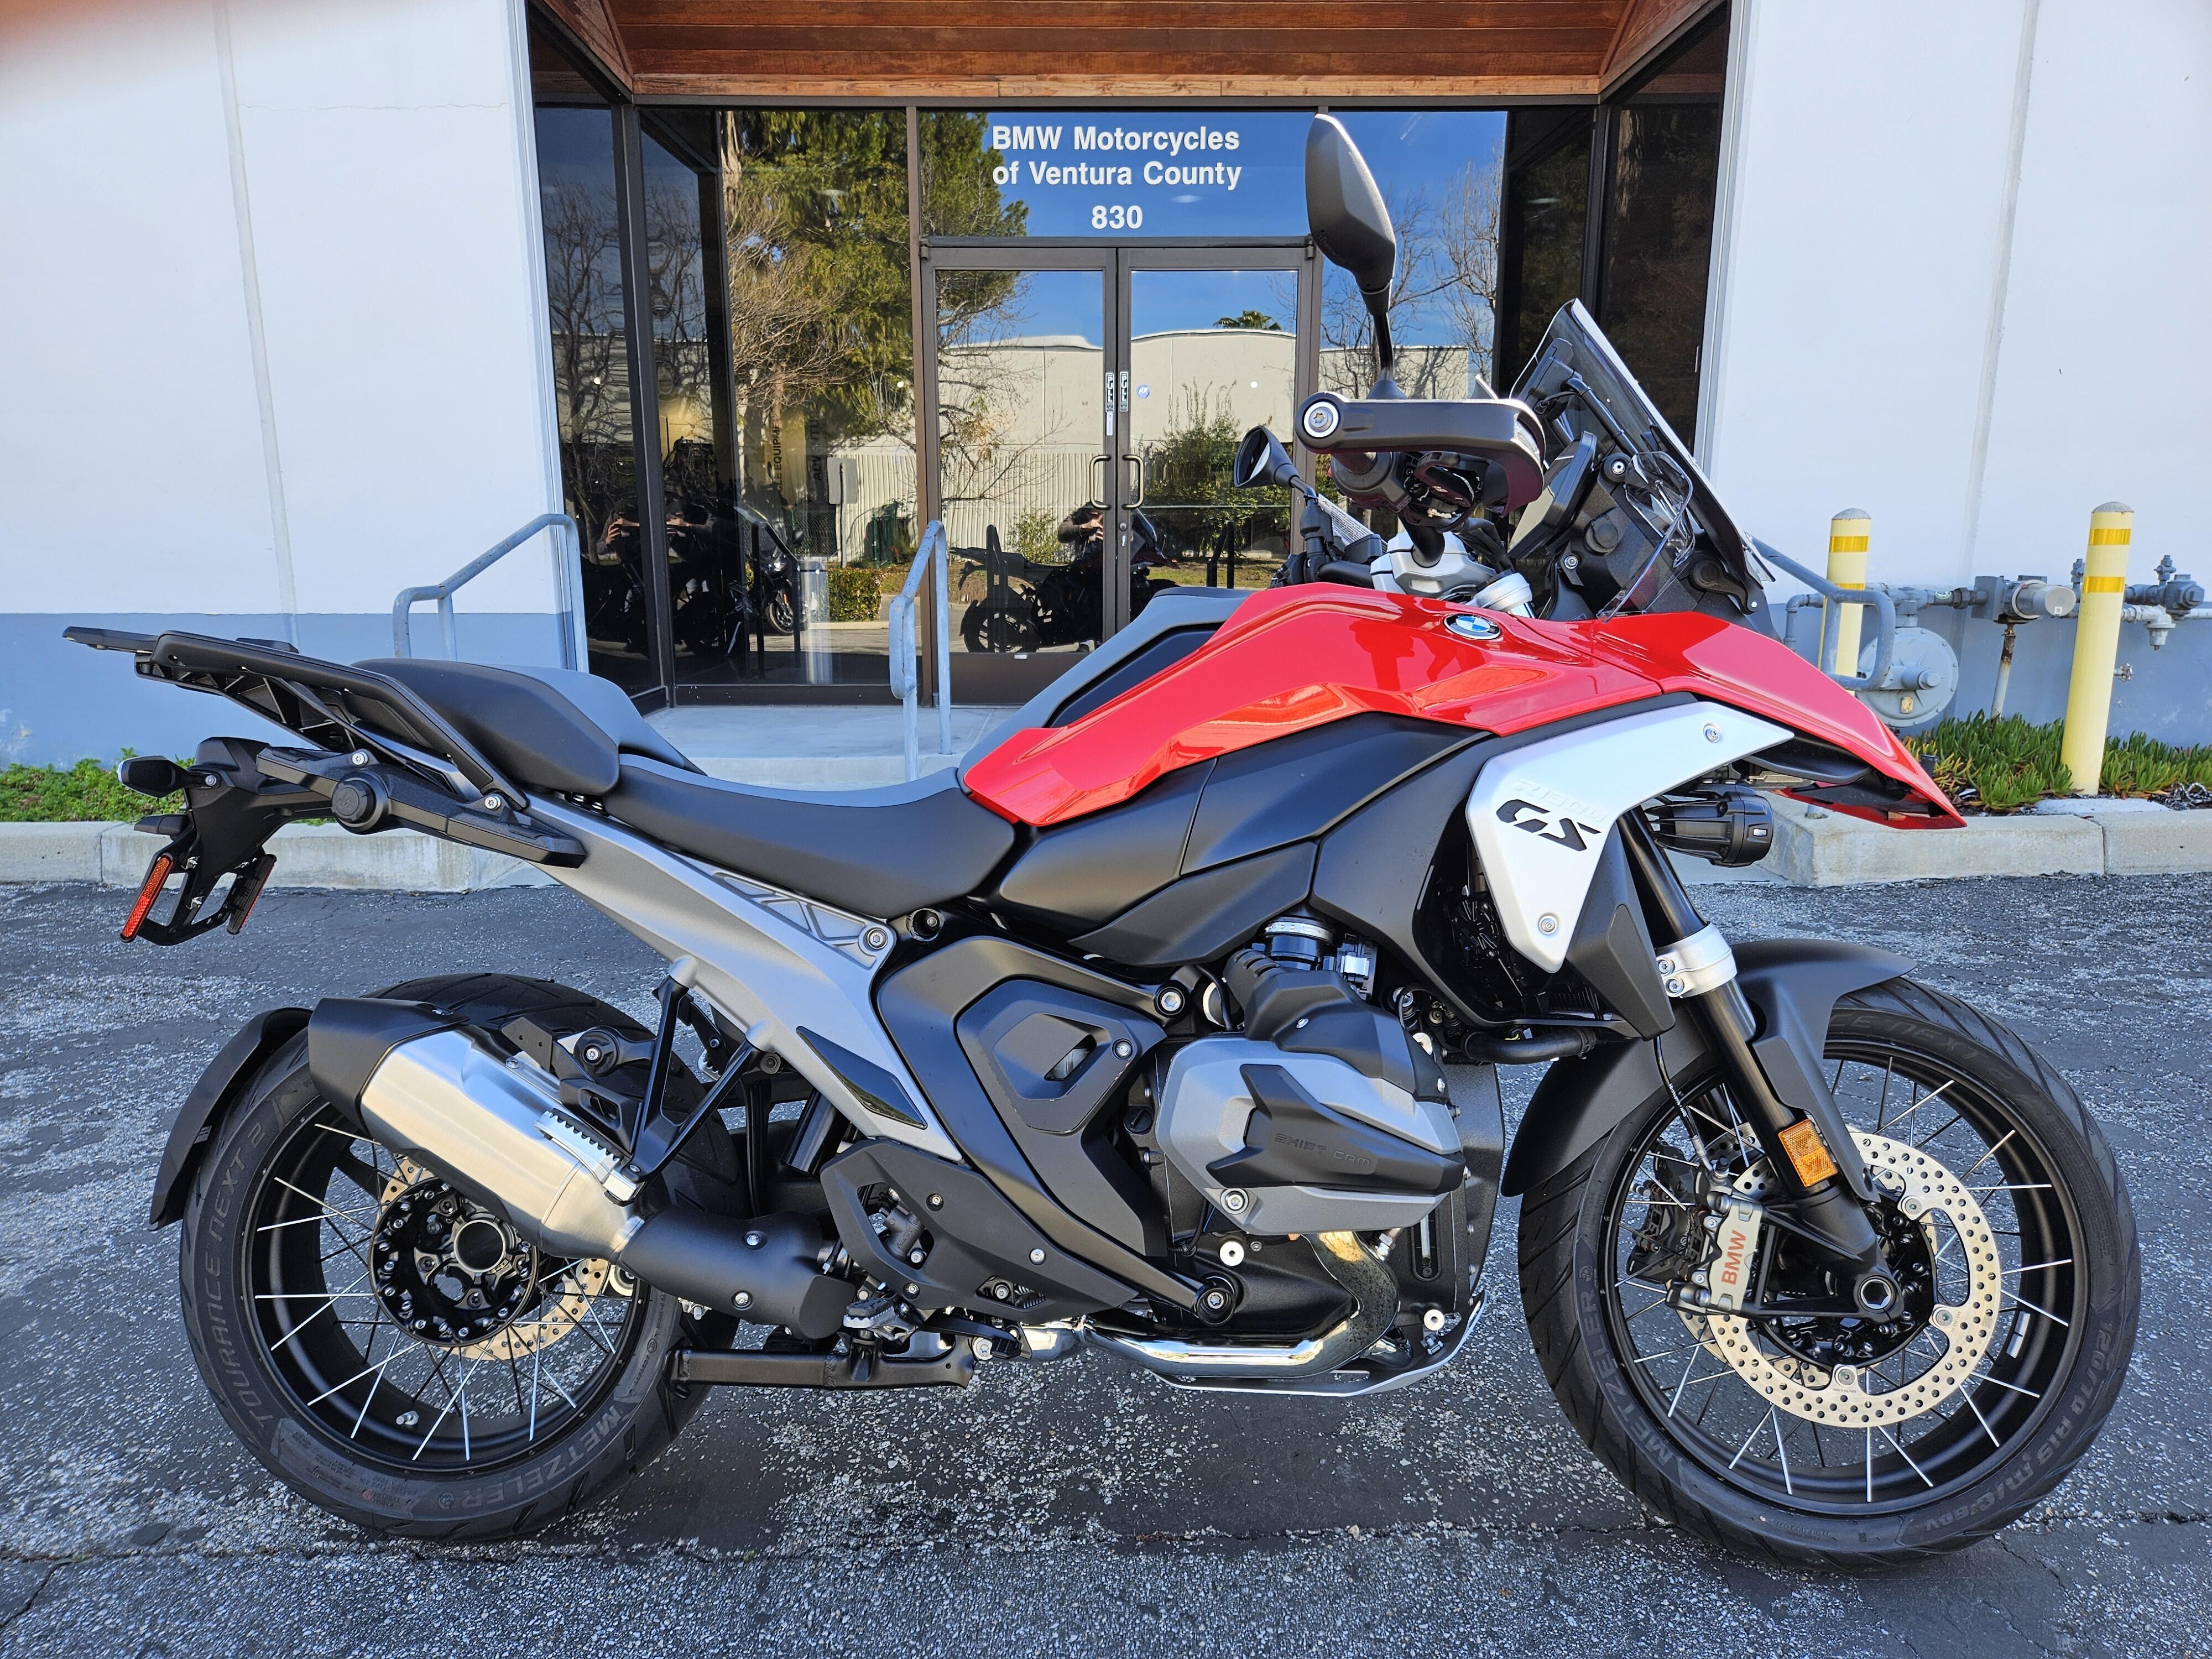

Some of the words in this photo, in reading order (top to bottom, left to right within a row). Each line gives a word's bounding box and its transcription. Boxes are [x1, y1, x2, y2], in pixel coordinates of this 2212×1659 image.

[993, 126, 1062, 150] BMW
[1074, 126, 1240, 156] Motorcycles
[992, 160, 1019, 185] of
[1028, 161, 1133, 185] Ventura
[1143, 160, 1242, 191] County
[1091, 205, 1143, 229] 830
[1496, 799, 1602, 852] GS
[1274, 1133, 1327, 1155] SHIFT
[1333, 1150, 1371, 1168] CAM
[205, 1250, 274, 1430] TOURANCE
[247, 1122, 266, 1148] 2
[1721, 1229, 1746, 1285] BMW
[1579, 1290, 1675, 1470] METZELER
[2071, 1323, 2113, 1415] 120/70
[461, 1405, 625, 1509] METZELER
